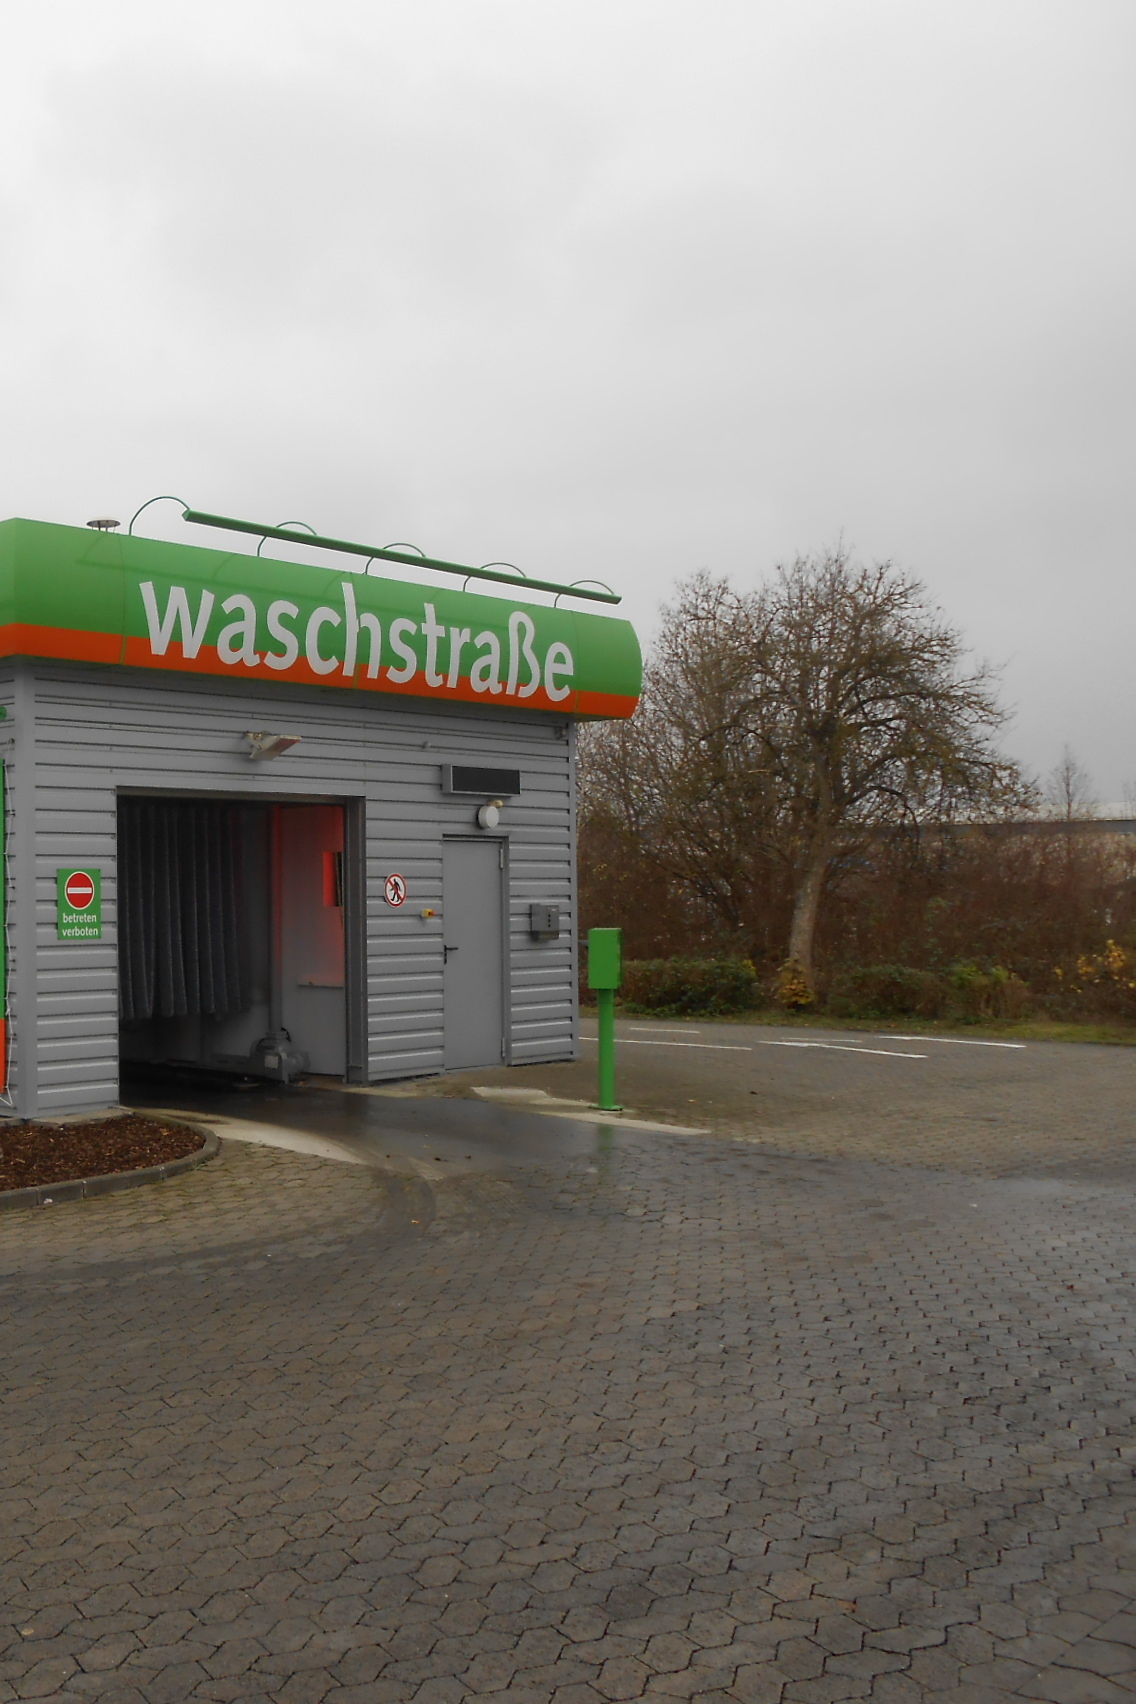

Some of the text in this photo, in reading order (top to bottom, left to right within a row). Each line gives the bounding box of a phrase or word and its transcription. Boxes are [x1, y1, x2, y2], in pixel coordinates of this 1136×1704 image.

[139, 580, 575, 702] waschstraße
[62, 912, 97, 923] betreten
[61, 926, 99, 937] verboten
